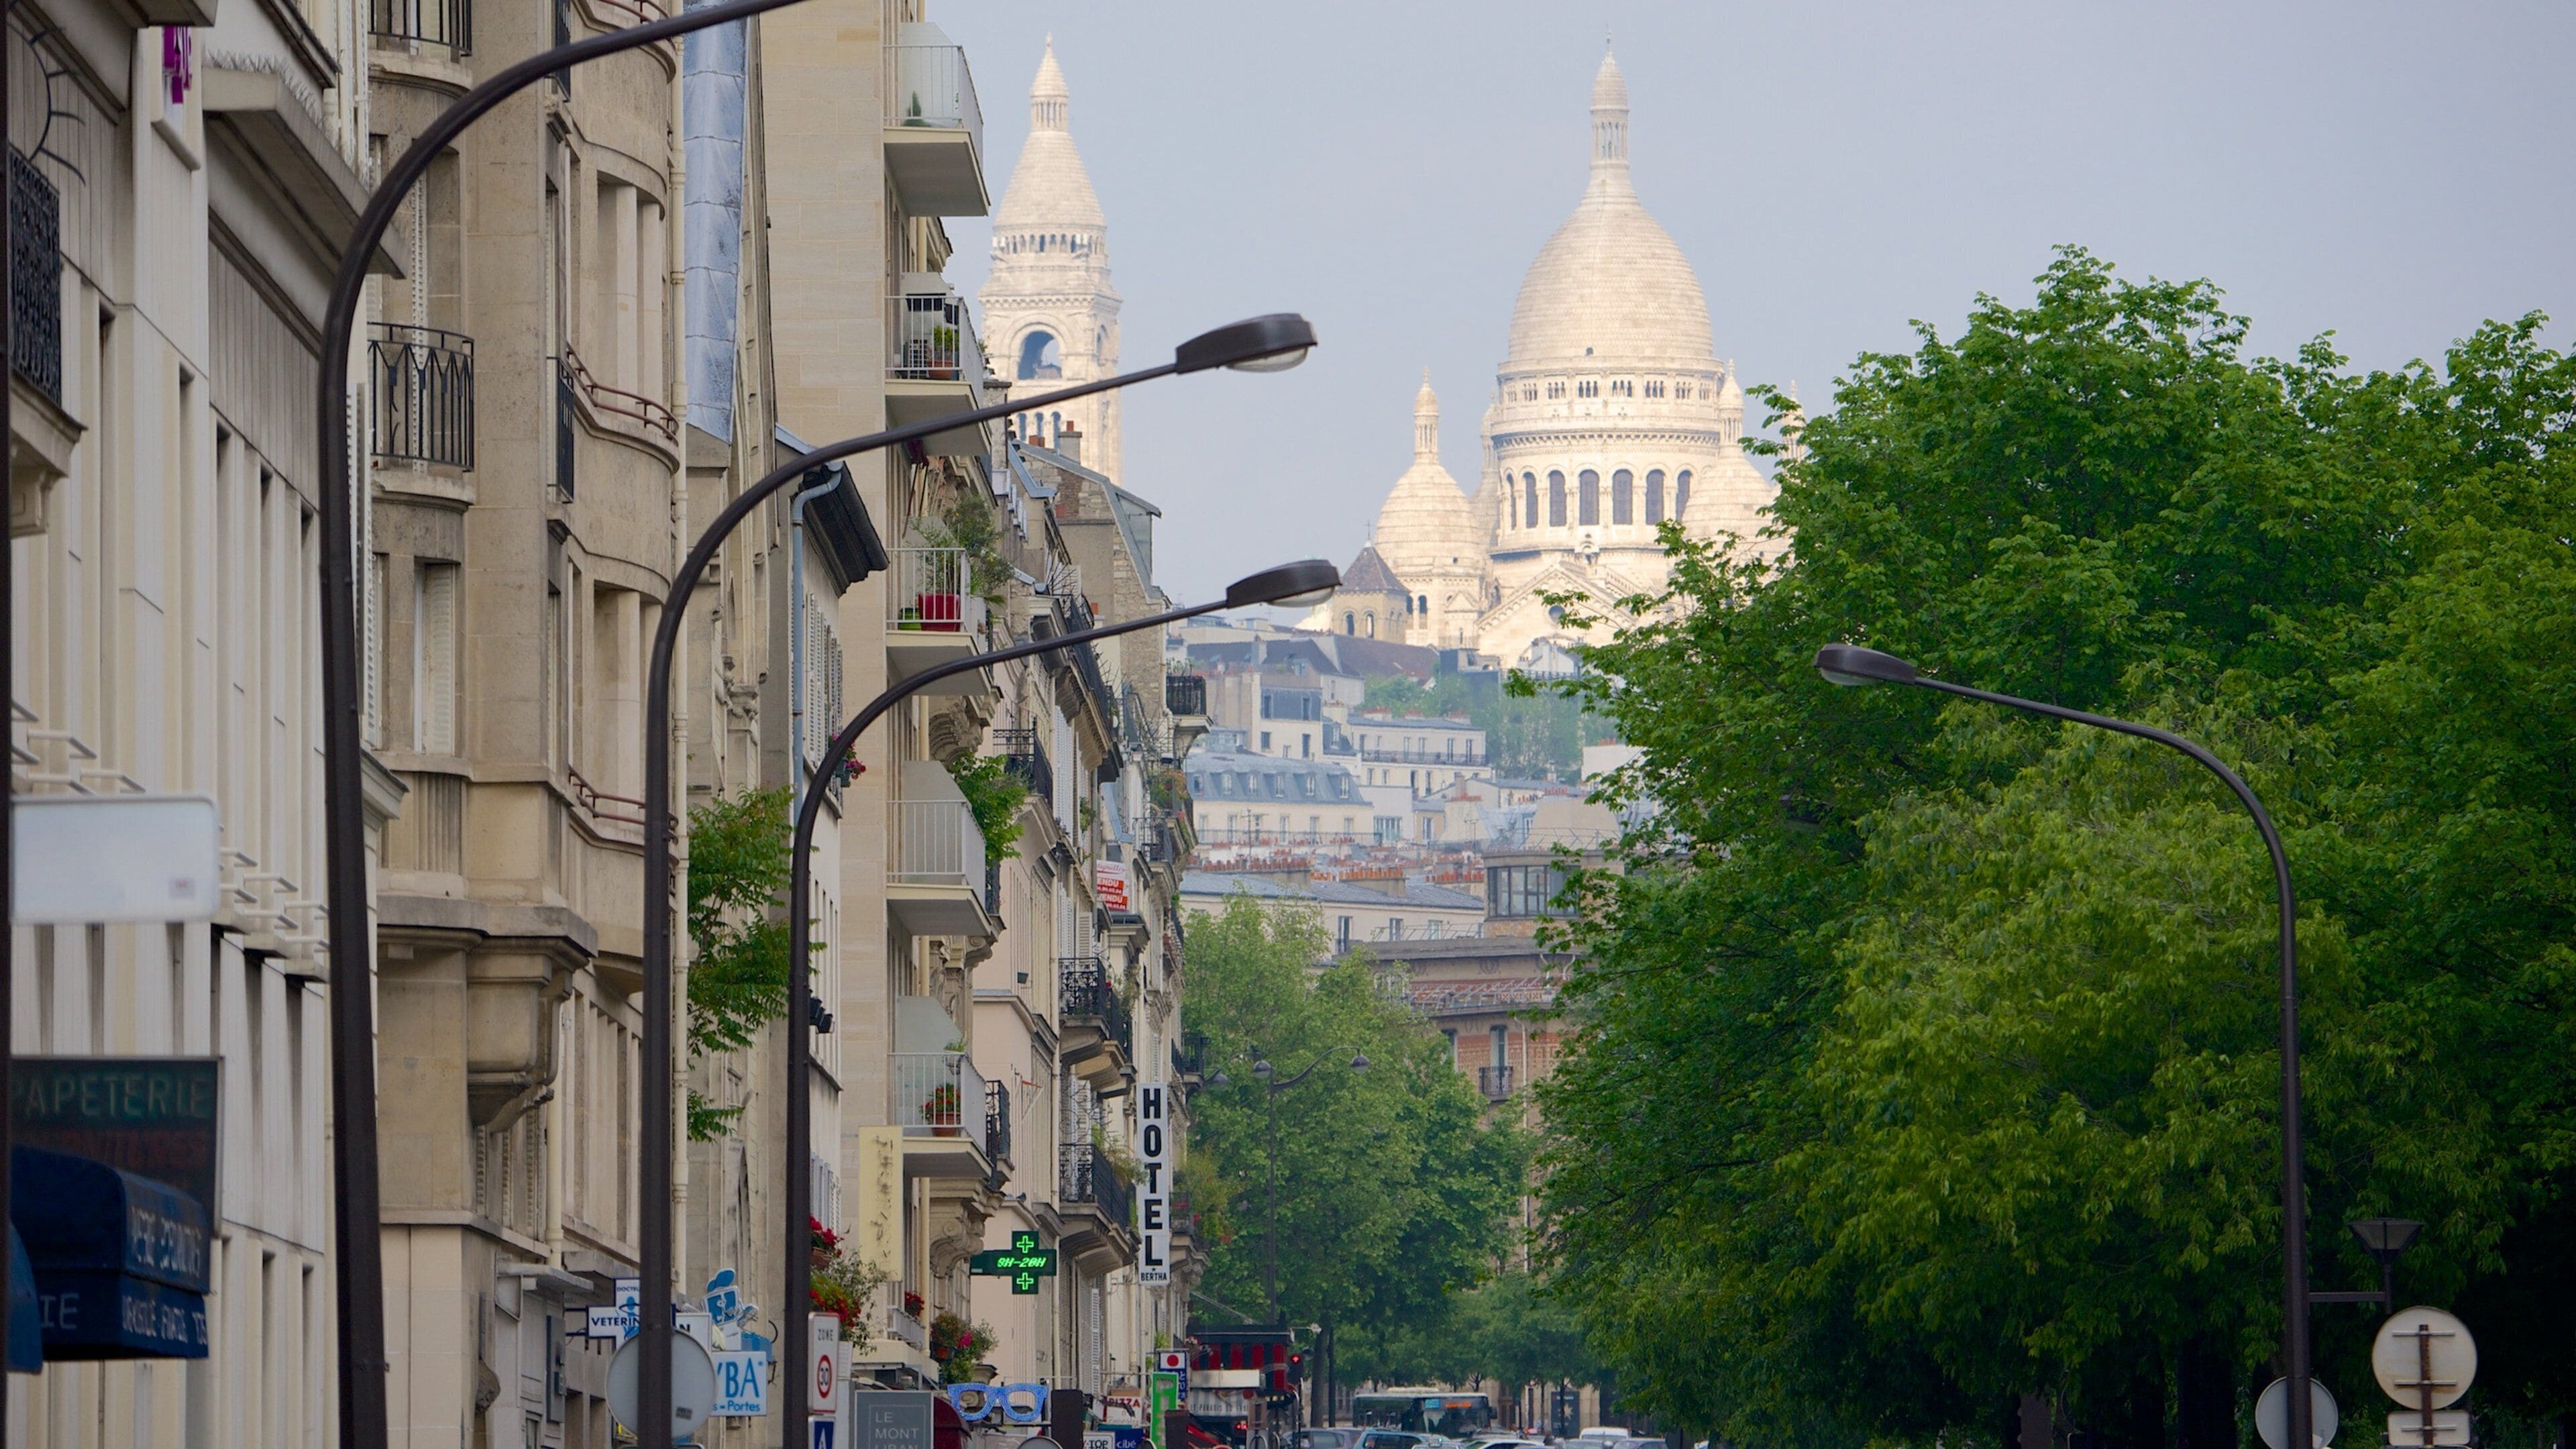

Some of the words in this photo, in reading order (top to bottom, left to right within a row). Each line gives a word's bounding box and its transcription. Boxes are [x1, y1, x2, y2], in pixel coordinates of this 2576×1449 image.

[1142, 1088, 1163, 1267] HOTEL
[1140, 1272, 1167, 1282] BERTHA
[818, 1330, 834, 1342] ZONE
[820, 1366, 829, 1386] 30
[875, 1412, 894, 1424] LE
[875, 1428, 919, 1439] MONT
